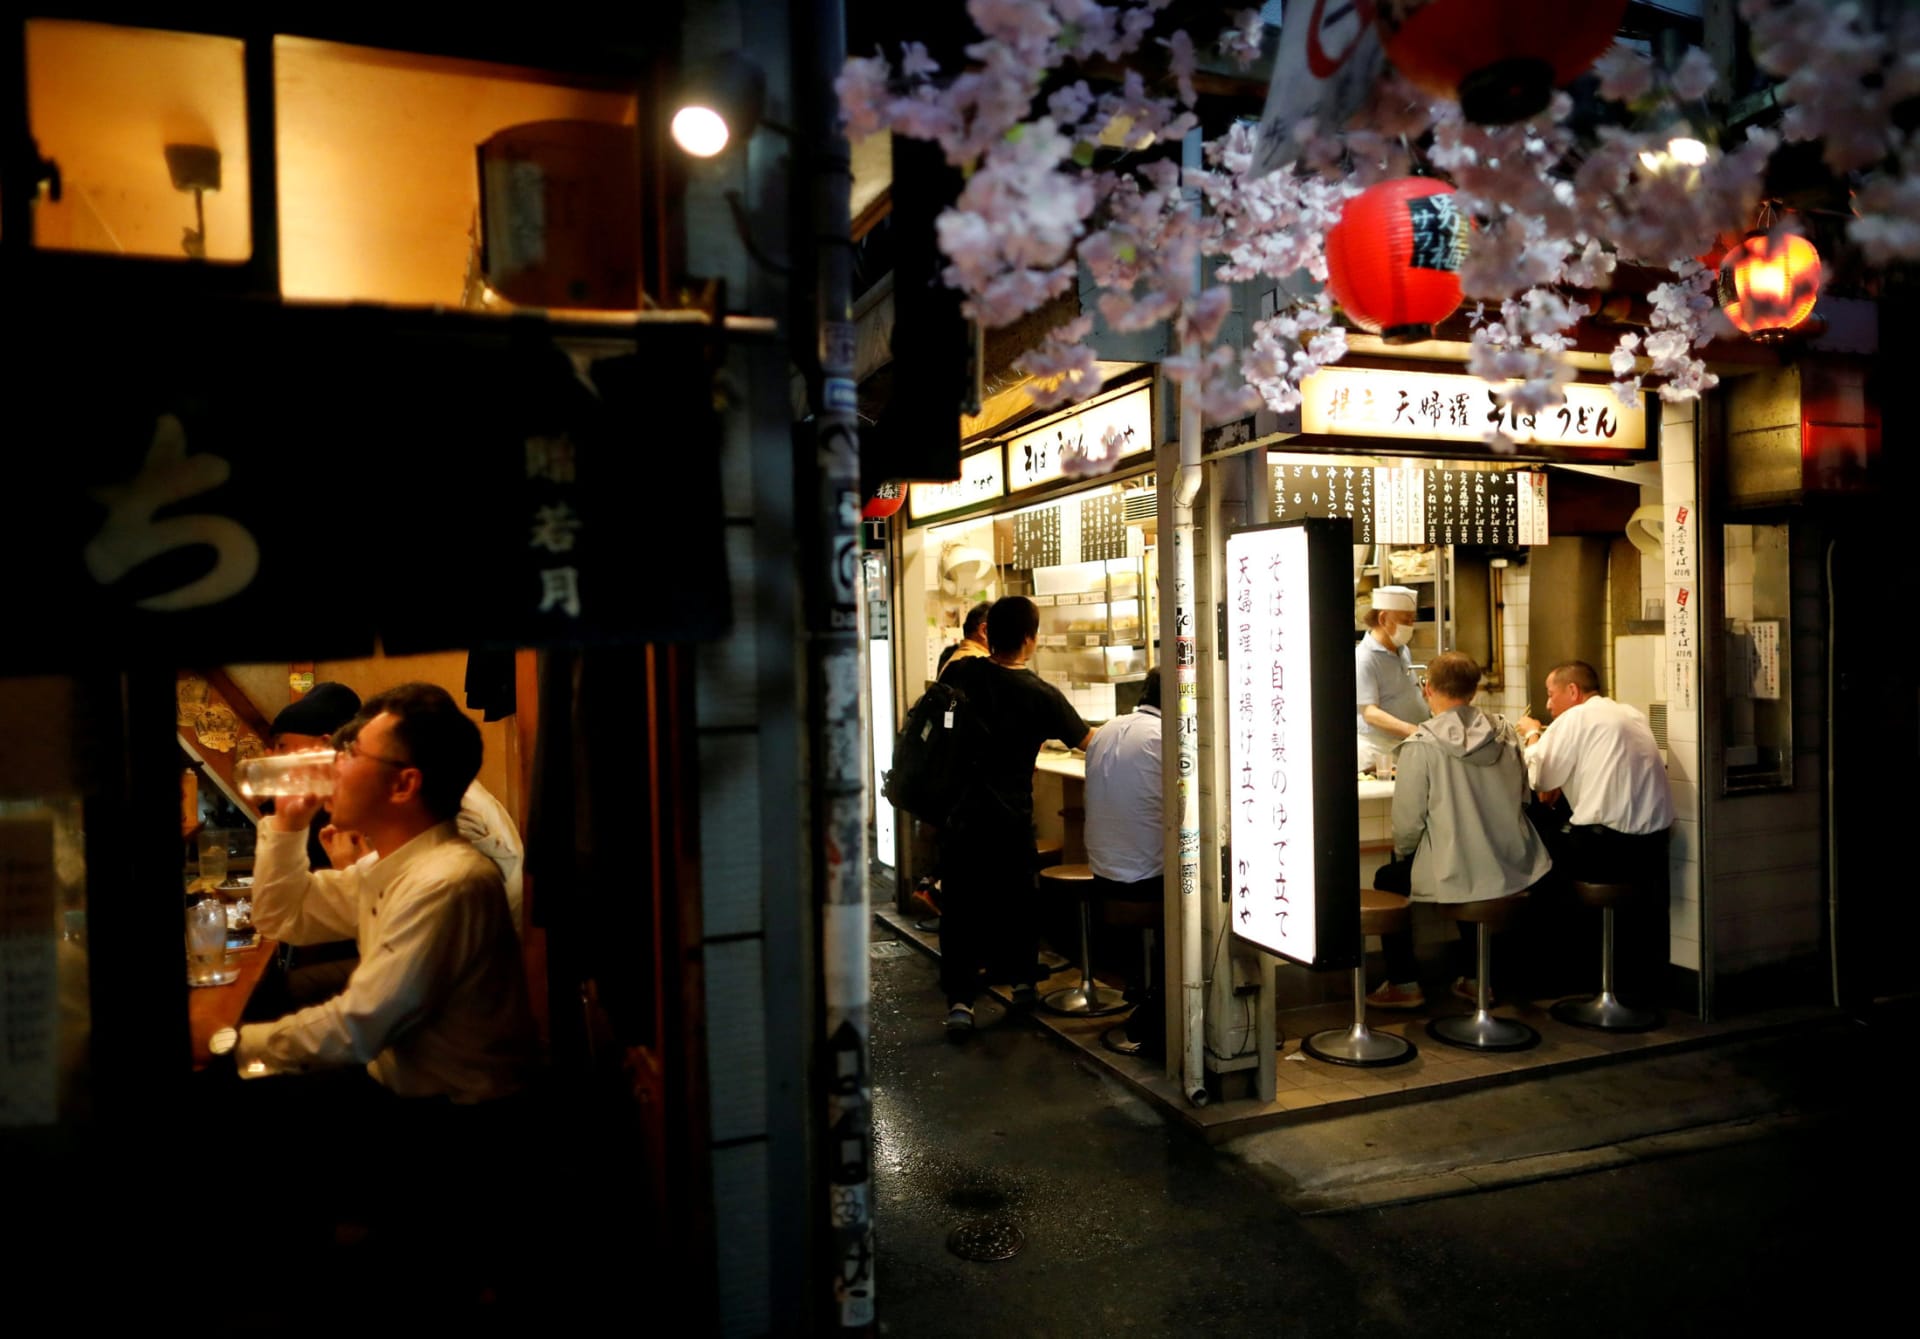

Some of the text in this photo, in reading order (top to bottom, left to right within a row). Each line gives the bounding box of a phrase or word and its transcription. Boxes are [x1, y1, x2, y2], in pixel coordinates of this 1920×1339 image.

[1391, 390, 1470, 428] 天婦羅
[1556, 393, 1618, 439] うどん
[1267, 552, 1290, 938] そばは自家製のゆで立て
[1237, 857, 1252, 926] かめや
